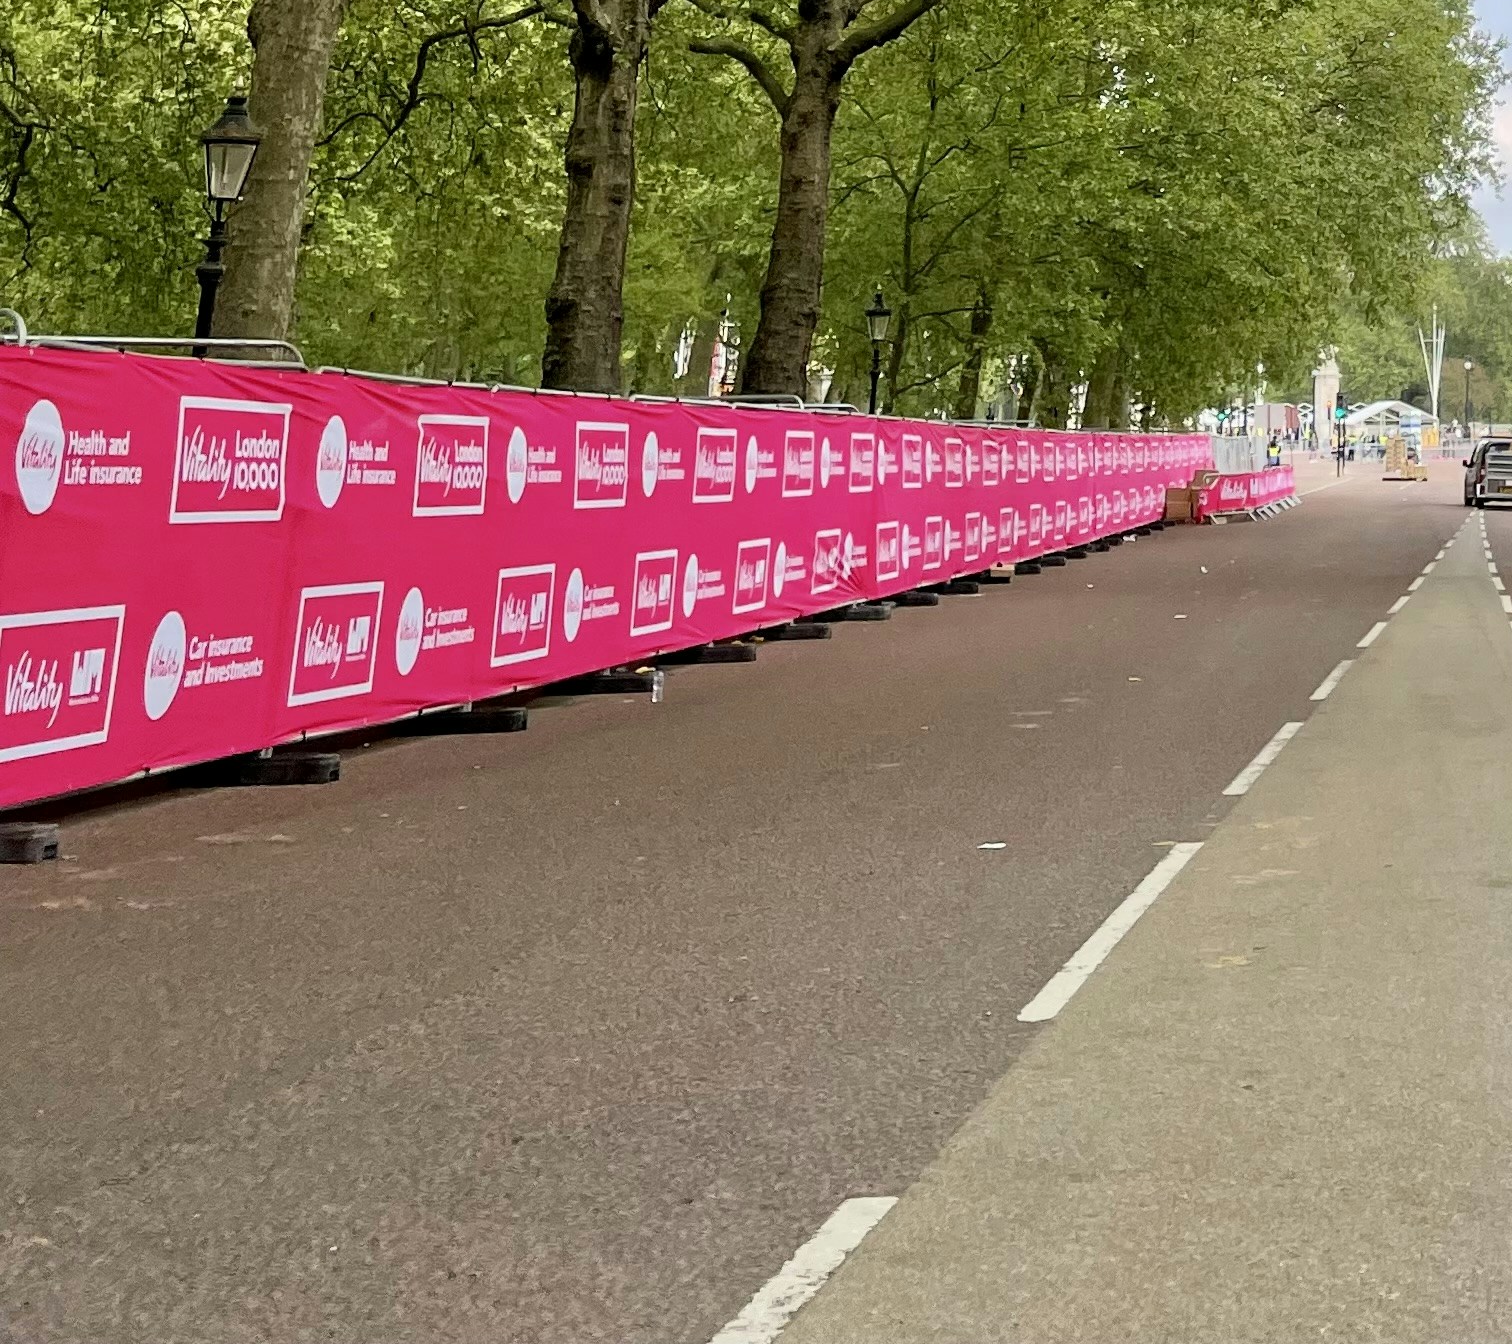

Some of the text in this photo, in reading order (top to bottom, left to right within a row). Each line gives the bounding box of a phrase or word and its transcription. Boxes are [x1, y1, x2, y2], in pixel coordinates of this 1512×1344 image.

[22, 432, 58, 481] Vitality
[67, 429, 131, 456] Health and
[235, 429, 280, 459] London
[63, 458, 143, 485] Life insurance
[182, 424, 232, 500] Vitality
[233, 461, 279, 492] 10,000
[189, 635, 208, 661] Car
[5, 650, 64, 729] Vitality
